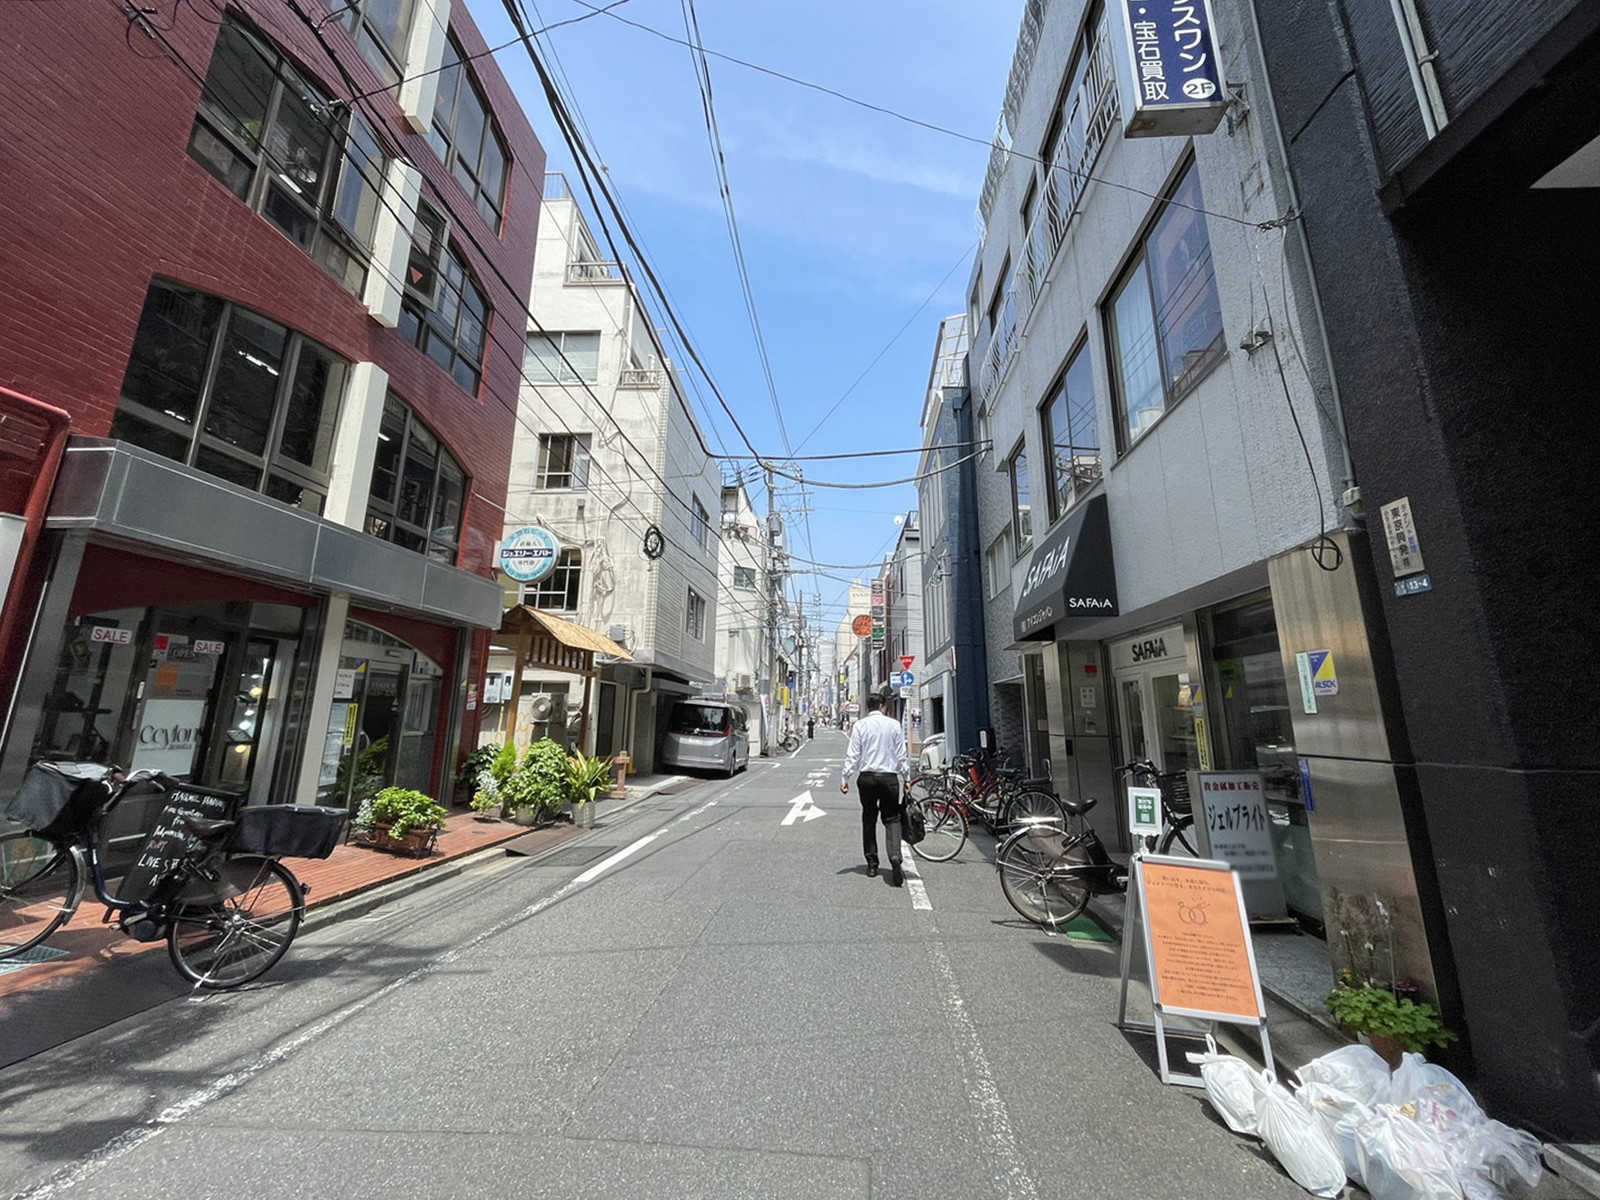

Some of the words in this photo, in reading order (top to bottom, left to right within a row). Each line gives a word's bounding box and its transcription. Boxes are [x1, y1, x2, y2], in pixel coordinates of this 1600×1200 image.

[1171, 0, 1206, 72] スワン
[1186, 82, 1212, 95] 2F
[93, 628, 129, 642] SALE
[195, 641, 222, 653] SALE
[140, 724, 204, 746] Ceylon
